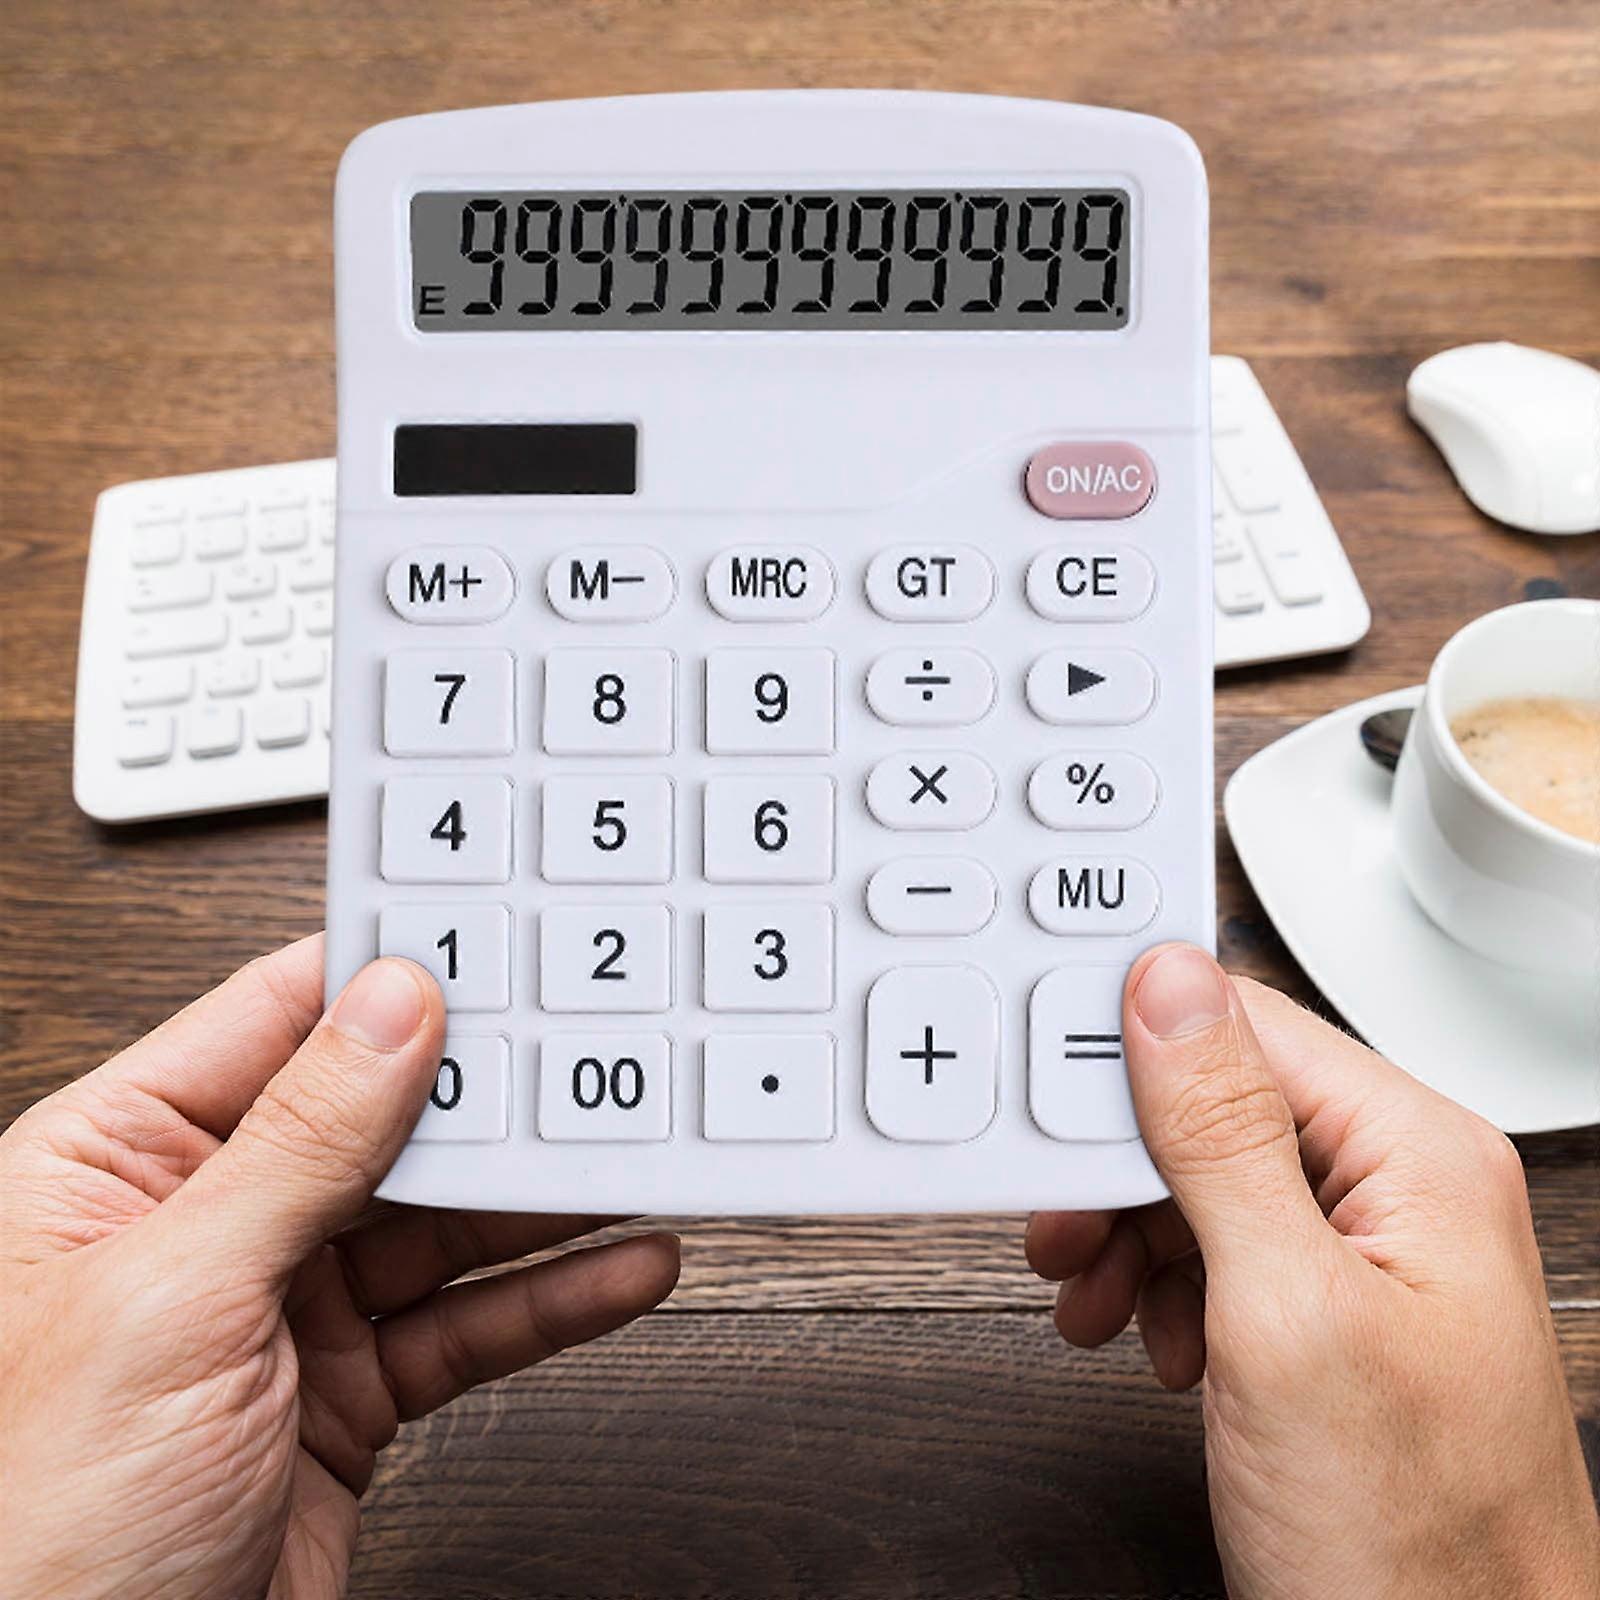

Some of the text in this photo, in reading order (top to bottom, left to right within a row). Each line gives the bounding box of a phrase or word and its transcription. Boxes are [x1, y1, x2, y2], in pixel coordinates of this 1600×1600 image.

[419, 286, 446, 315] E
[1046, 463, 1142, 496] ON/AC
[408, 564, 482, 602] M+
[732, 558, 807, 599] MRC
[897, 558, 956, 599] GT
[1056, 558, 1118, 598] CE
[435, 674, 467, 725] 7
[593, 674, 627, 725] 8
[754, 674, 788, 724] 9
[1066, 763, 1115, 805] %
[430, 801, 467, 852] 4
[593, 801, 627, 851] 5
[754, 801, 788, 852] 6
[1058, 868, 1126, 910] MU
[437, 929, 457, 980] 1
[591, 929, 626, 980] 2
[754, 929, 788, 980] 3
[430, 1057, 463, 1111] 0
[572, 1057, 645, 1110] 00
